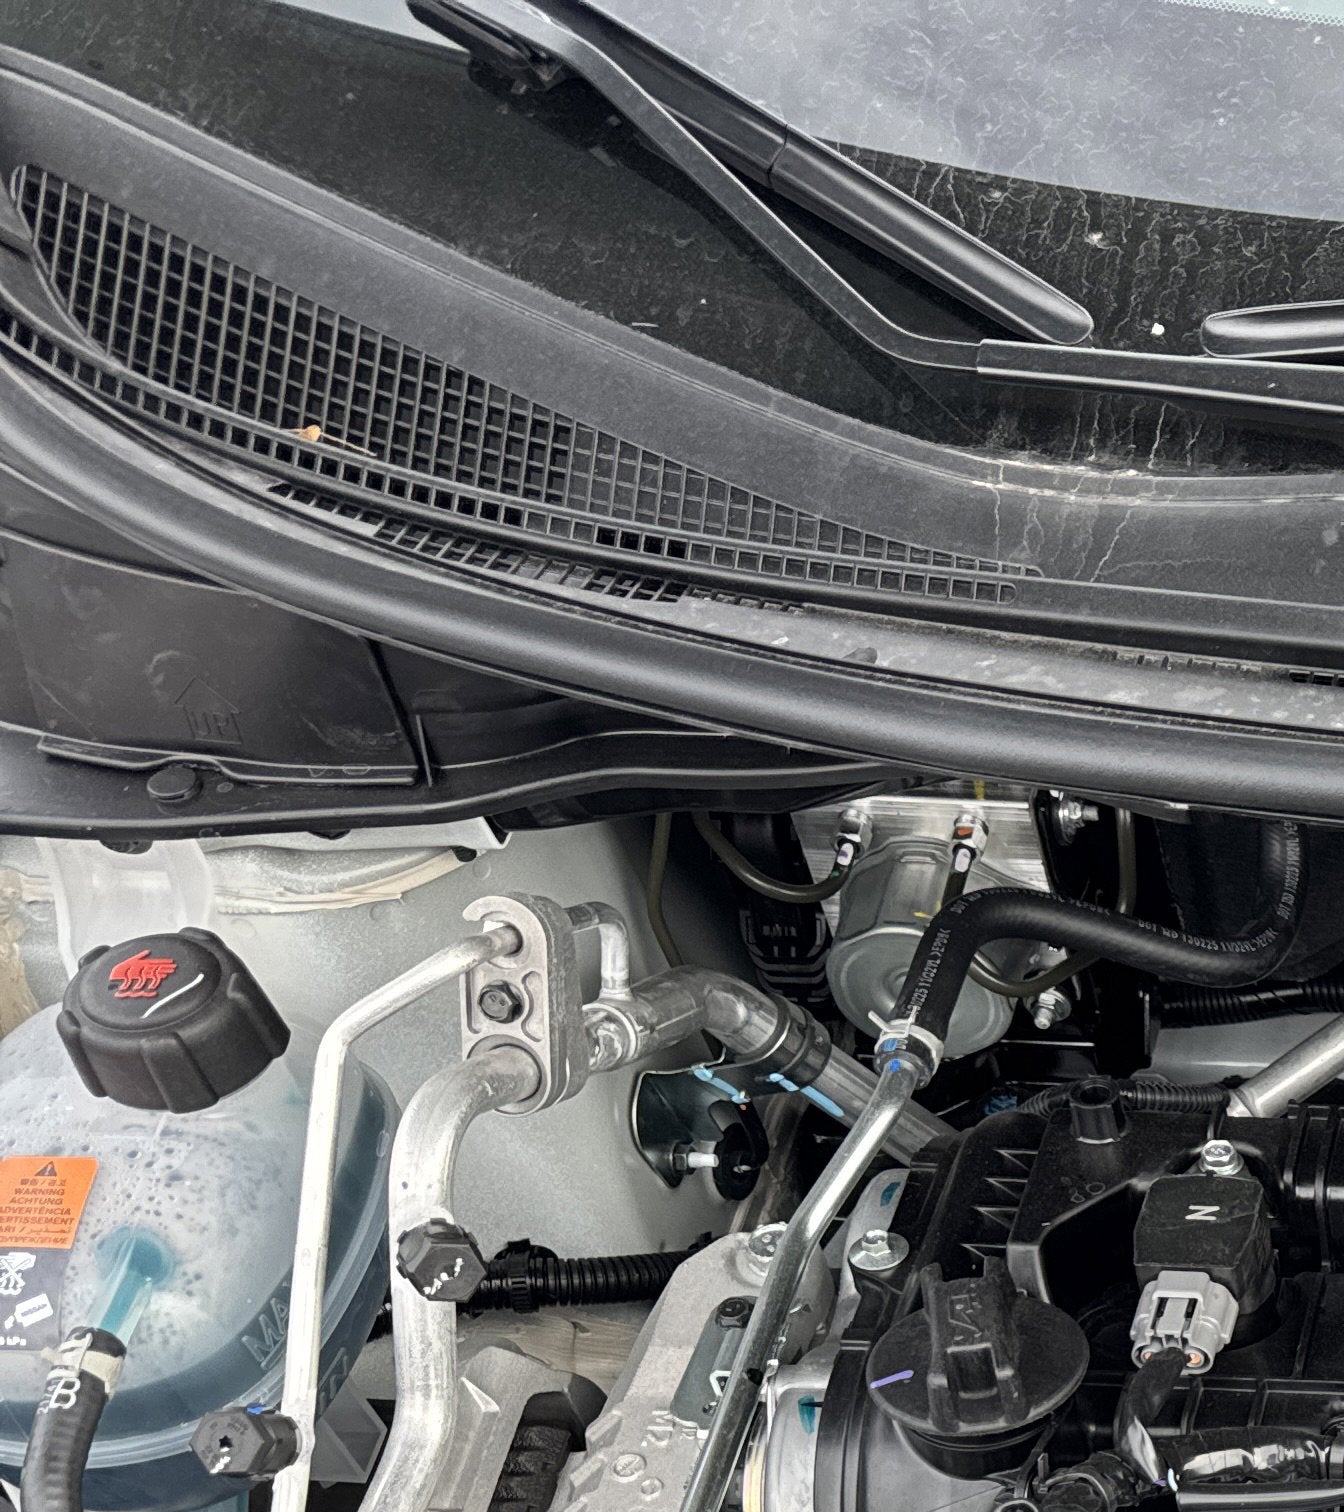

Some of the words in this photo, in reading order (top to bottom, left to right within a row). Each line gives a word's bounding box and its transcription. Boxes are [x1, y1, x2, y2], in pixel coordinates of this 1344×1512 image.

[14, 1188, 65, 1196] WARNING
[9, 1197, 63, 1205] ACHTUNG
[49, 1376, 81, 1410] B
